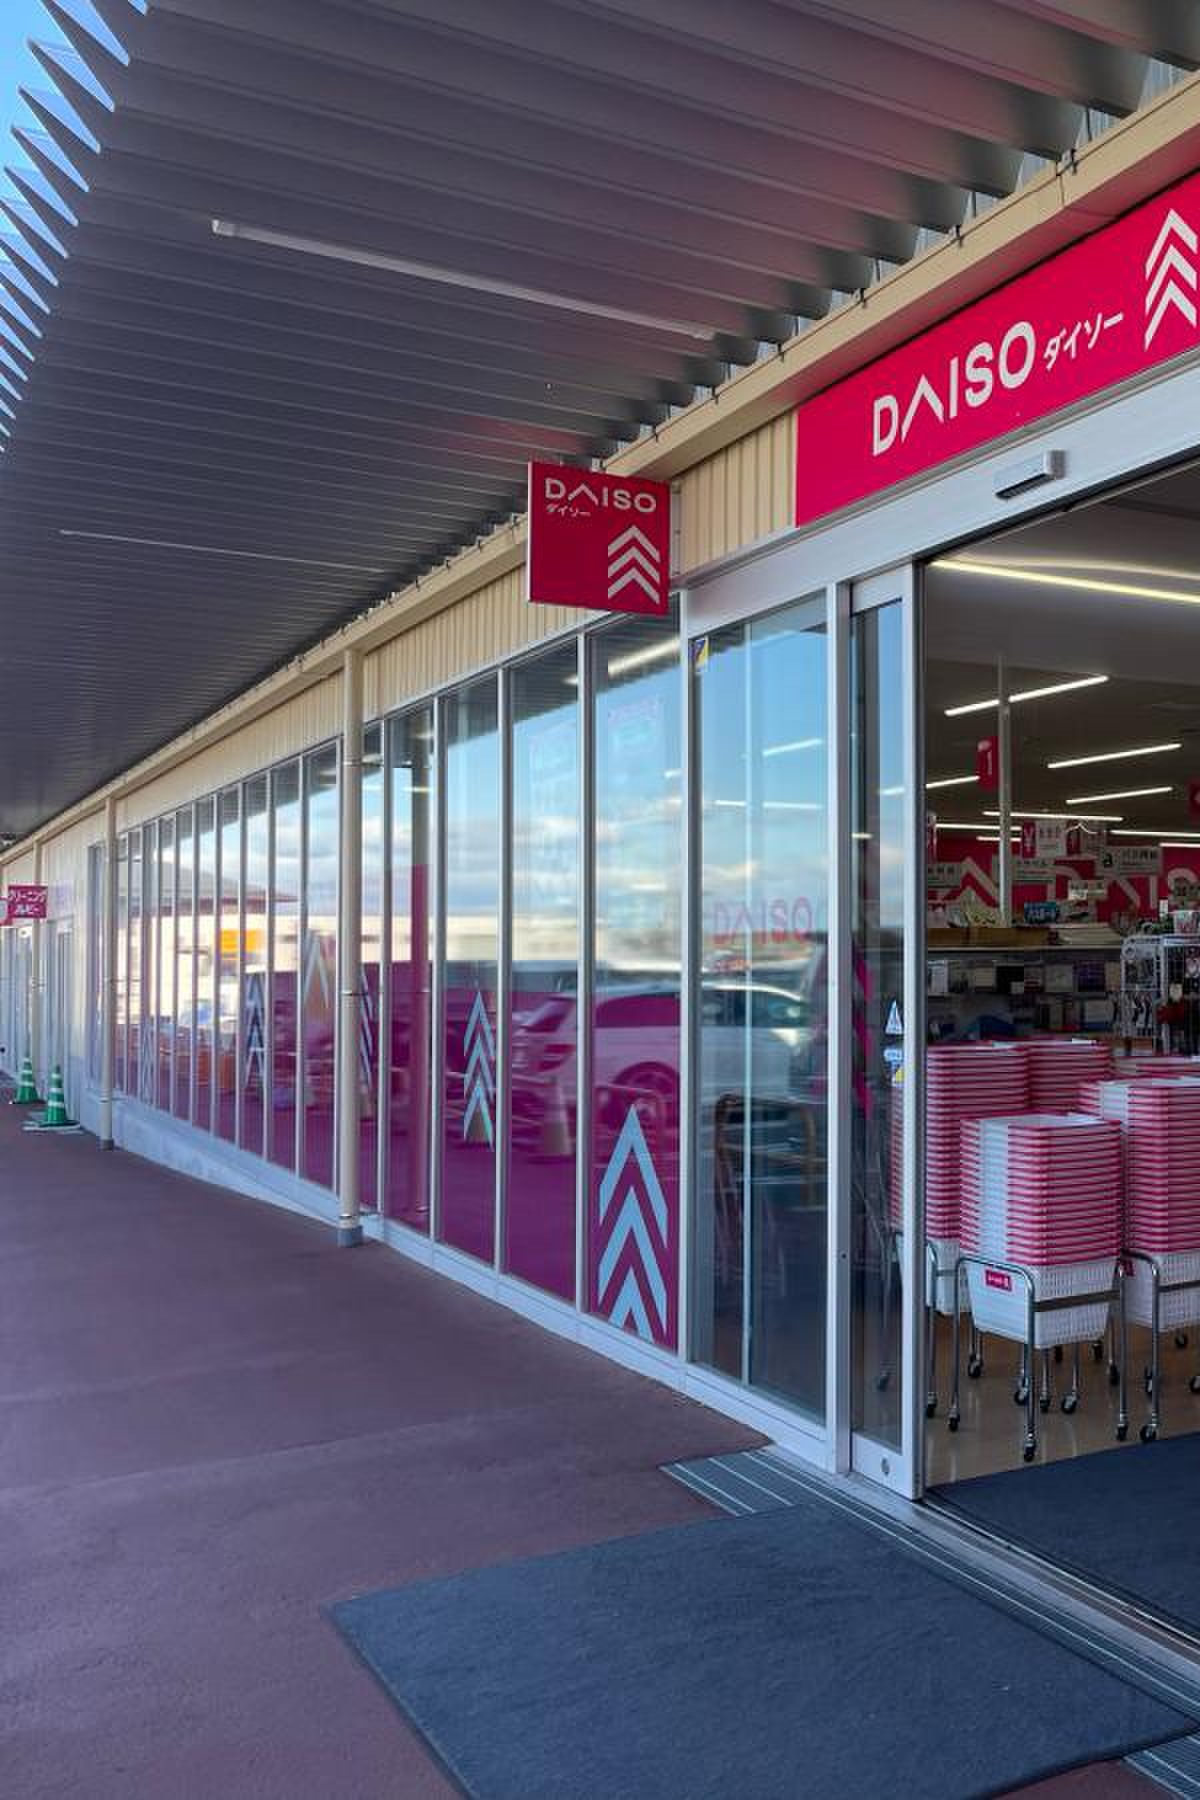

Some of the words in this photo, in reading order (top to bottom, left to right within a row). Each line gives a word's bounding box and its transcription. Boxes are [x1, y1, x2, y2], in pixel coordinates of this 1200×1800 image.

[1043, 312, 1124, 371] ダイソー
[873, 321, 1036, 457] DAISO
[545, 477, 657, 513] DAISO
[545, 504, 592, 518] ダイソー
